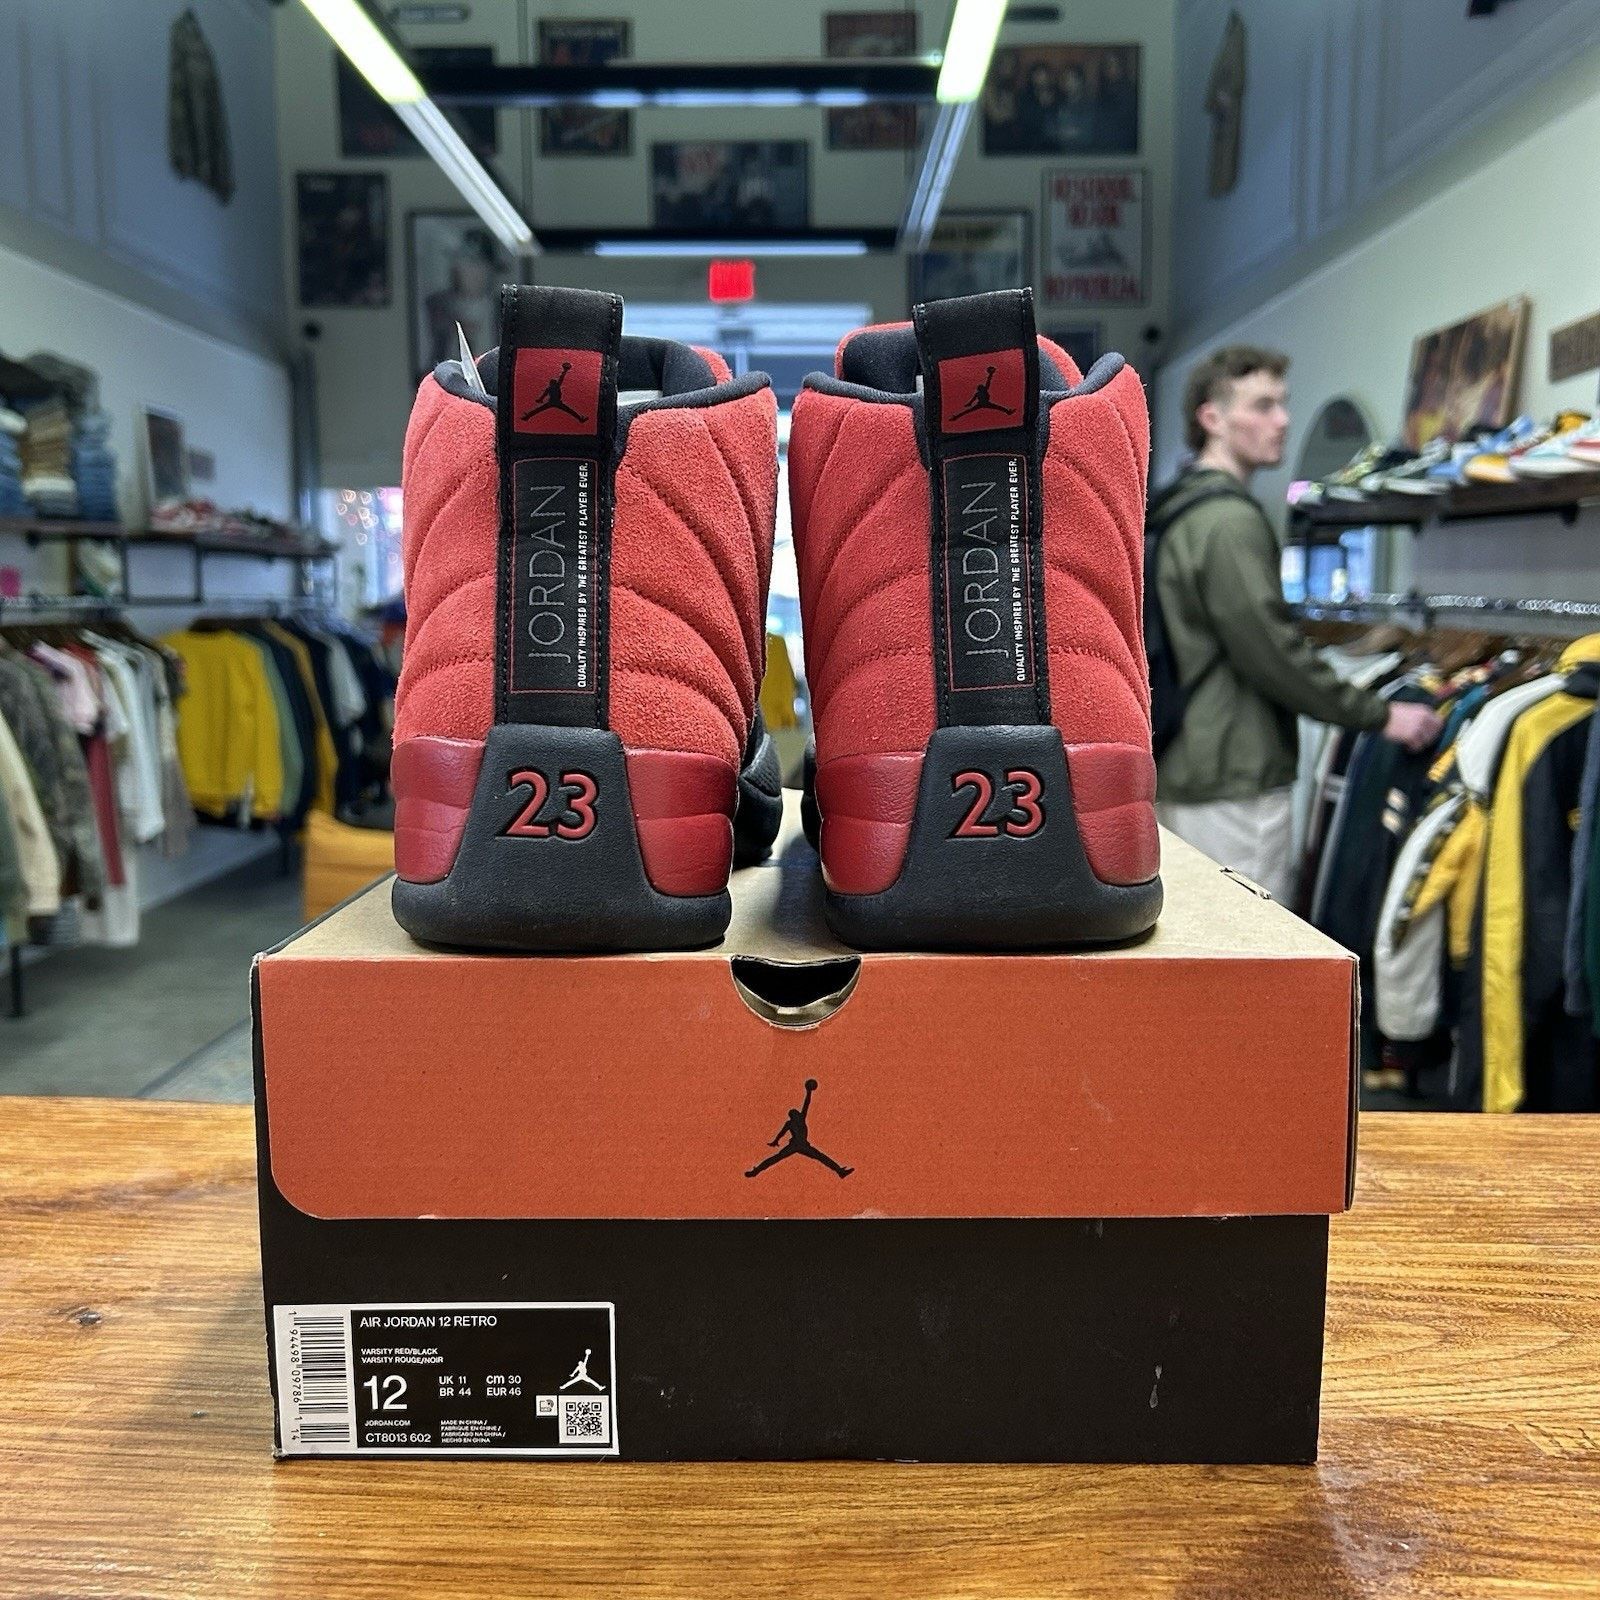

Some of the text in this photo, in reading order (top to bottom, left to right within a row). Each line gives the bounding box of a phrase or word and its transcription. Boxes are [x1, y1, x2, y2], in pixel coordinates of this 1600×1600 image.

[528, 485, 571, 663] JORDAN
[577, 462, 588, 687] QUALITY INSPIRED BY THE GREATEST PLAYER EVER.
[961, 482, 1009, 658] JORDAN
[1008, 458, 1025, 682] QUALITY INSPIRED BY THE GREATEST PLAYER EVER.
[503, 769, 599, 840] 23
[950, 769, 1045, 839] 23
[360, 1315, 497, 1328] AIR JORDAN 12 RETRO
[290, 1329, 300, 1362] 94498
[395, 1356, 444, 1364] ROUGE/NOIR
[291, 1370, 302, 1403] 09786
[363, 1375, 408, 1410] 12
[438, 1376, 467, 1385] UK 11
[439, 1388, 472, 1396] BR 44
[486, 1375, 522, 1384] cm 30
[486, 1387, 522, 1396] EUR 46
[365, 1419, 411, 1427] JORDAN.COM
[365, 1433, 432, 1443] CT8013 602
